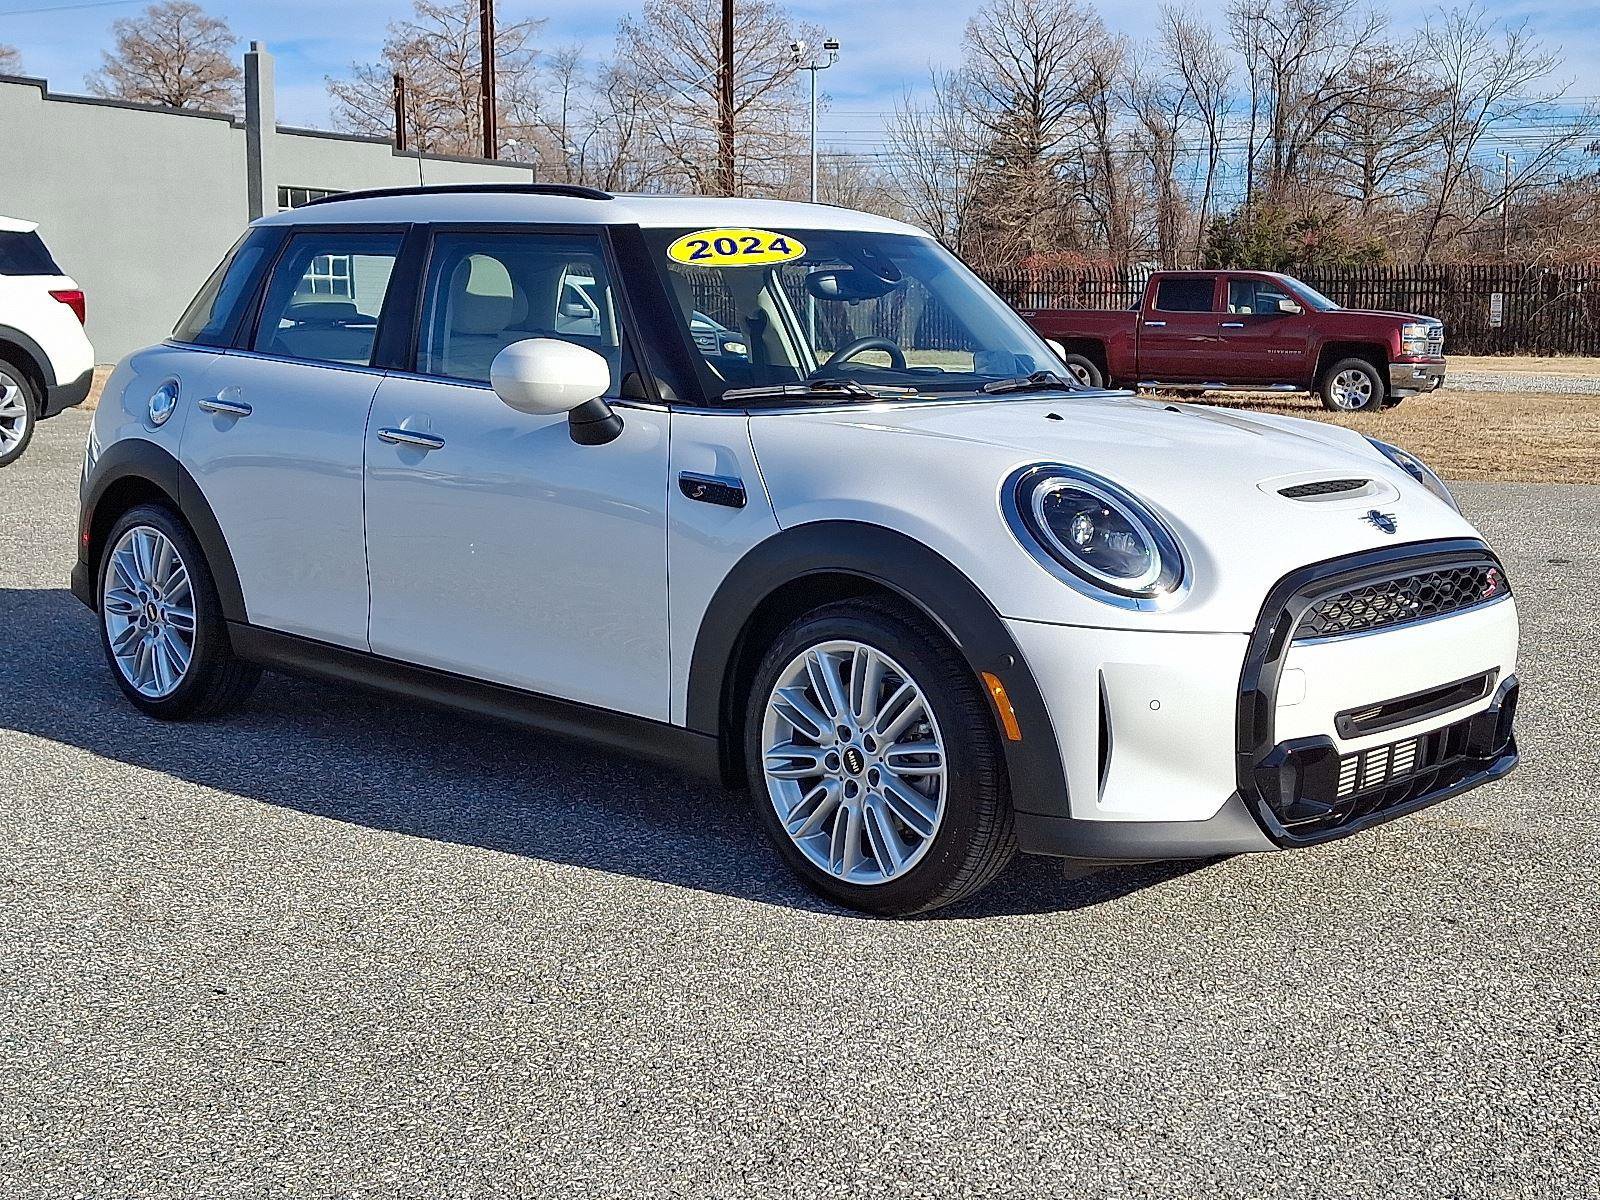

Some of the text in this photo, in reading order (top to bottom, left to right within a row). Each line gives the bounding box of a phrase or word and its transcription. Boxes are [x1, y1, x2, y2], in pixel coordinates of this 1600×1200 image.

[686, 236, 792, 260] 2024
[1482, 567, 1498, 598] S
[848, 750, 860, 772] MINI
